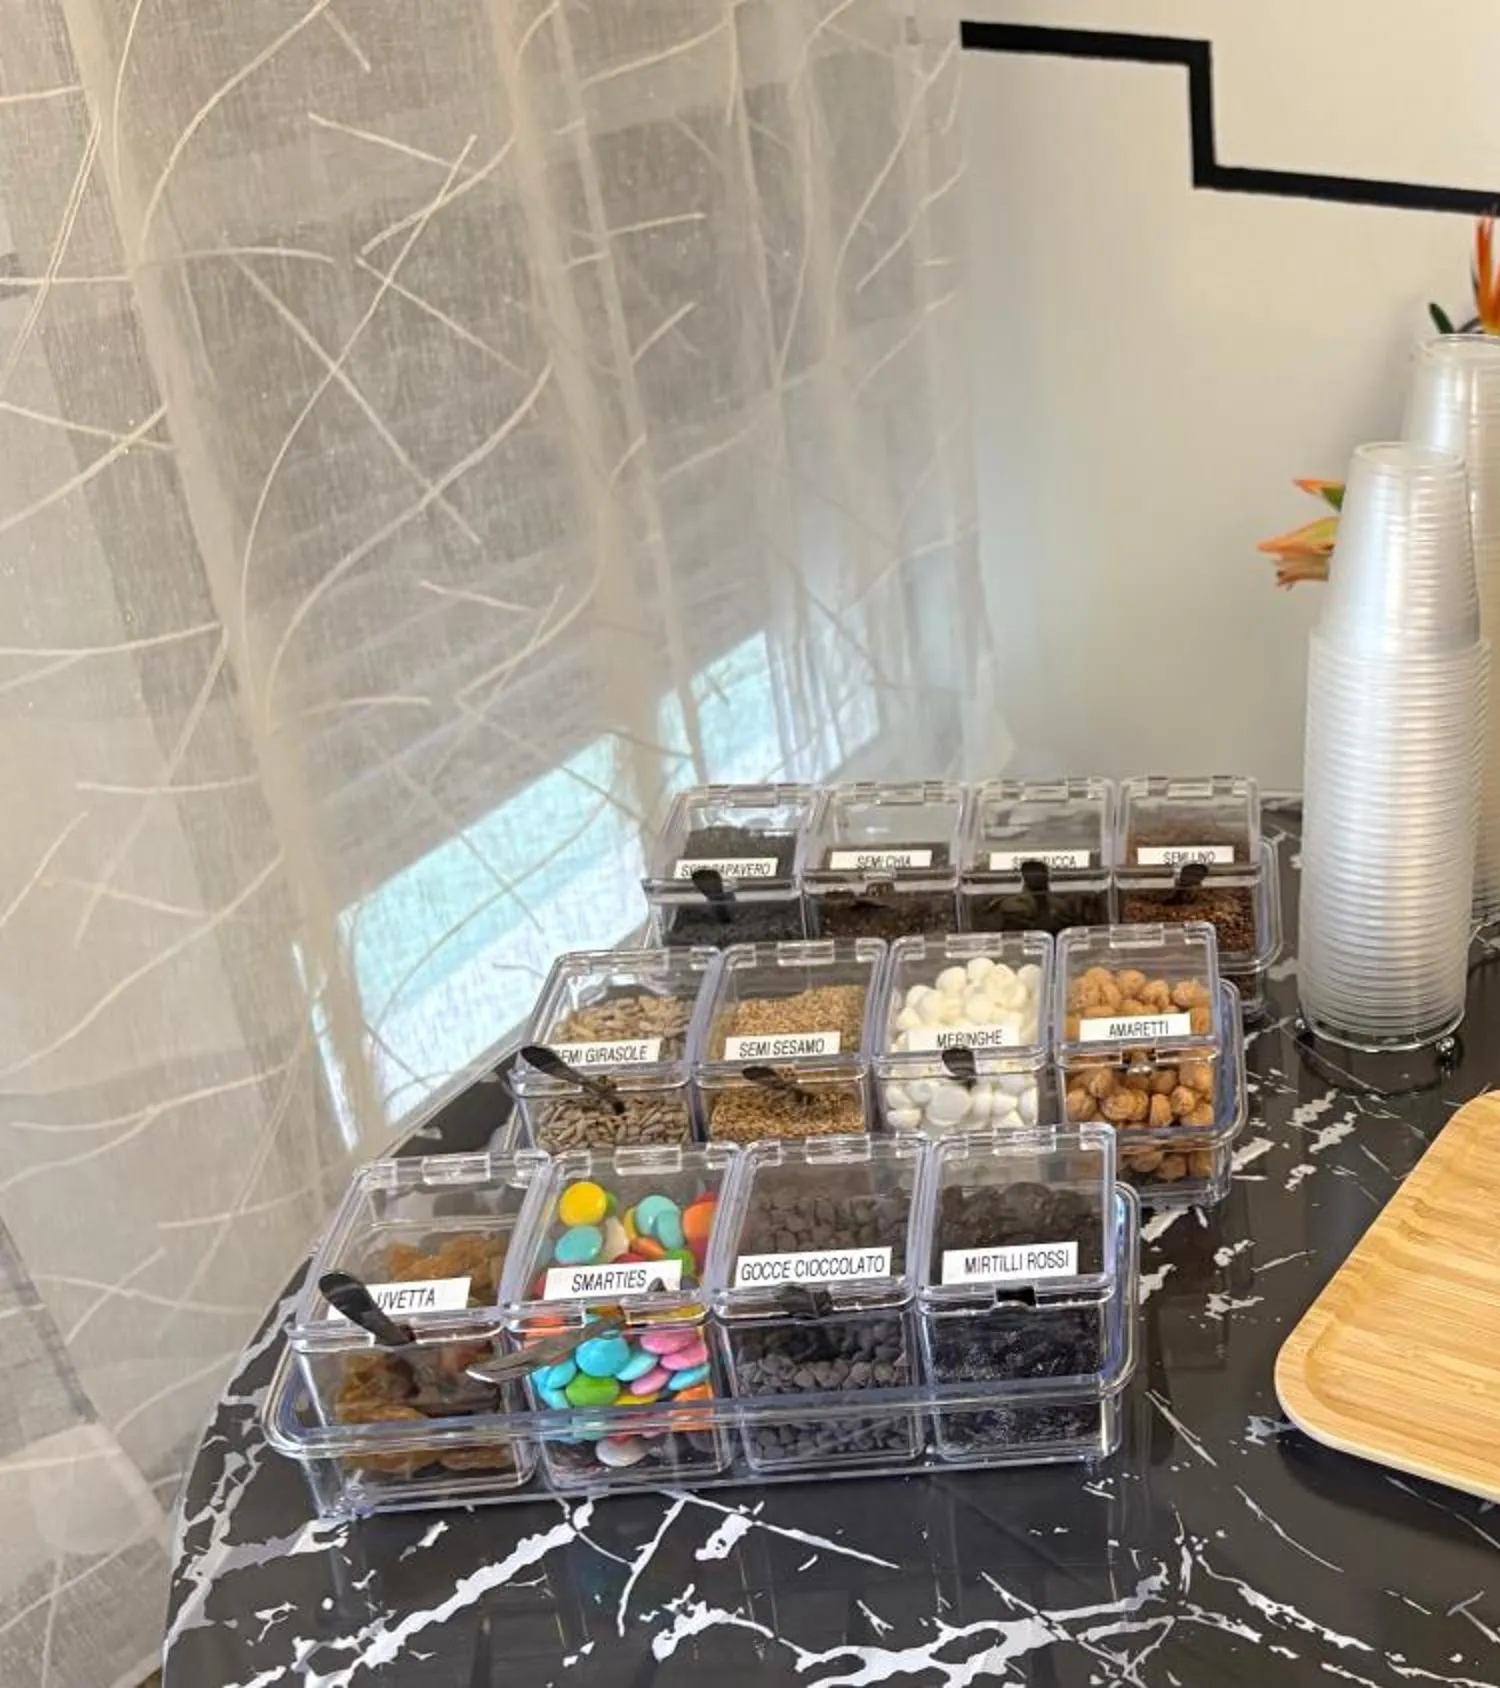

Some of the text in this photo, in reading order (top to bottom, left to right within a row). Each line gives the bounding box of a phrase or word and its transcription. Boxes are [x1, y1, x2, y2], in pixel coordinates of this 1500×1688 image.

[936, 1029, 1003, 1049] MERINGHE
[1109, 1020, 1169, 1037] AMARETTI
[558, 1044, 648, 1064] EMI GIRASOLE
[739, 1038, 825, 1057] SEMI SESAMO
[741, 1254, 885, 1281] GOCCE CIOCCOLATO
[964, 1249, 1069, 1275] MIRTILLI ROSSI
[571, 1269, 647, 1293] SMARTIES
[377, 1286, 436, 1310] UVETTA
